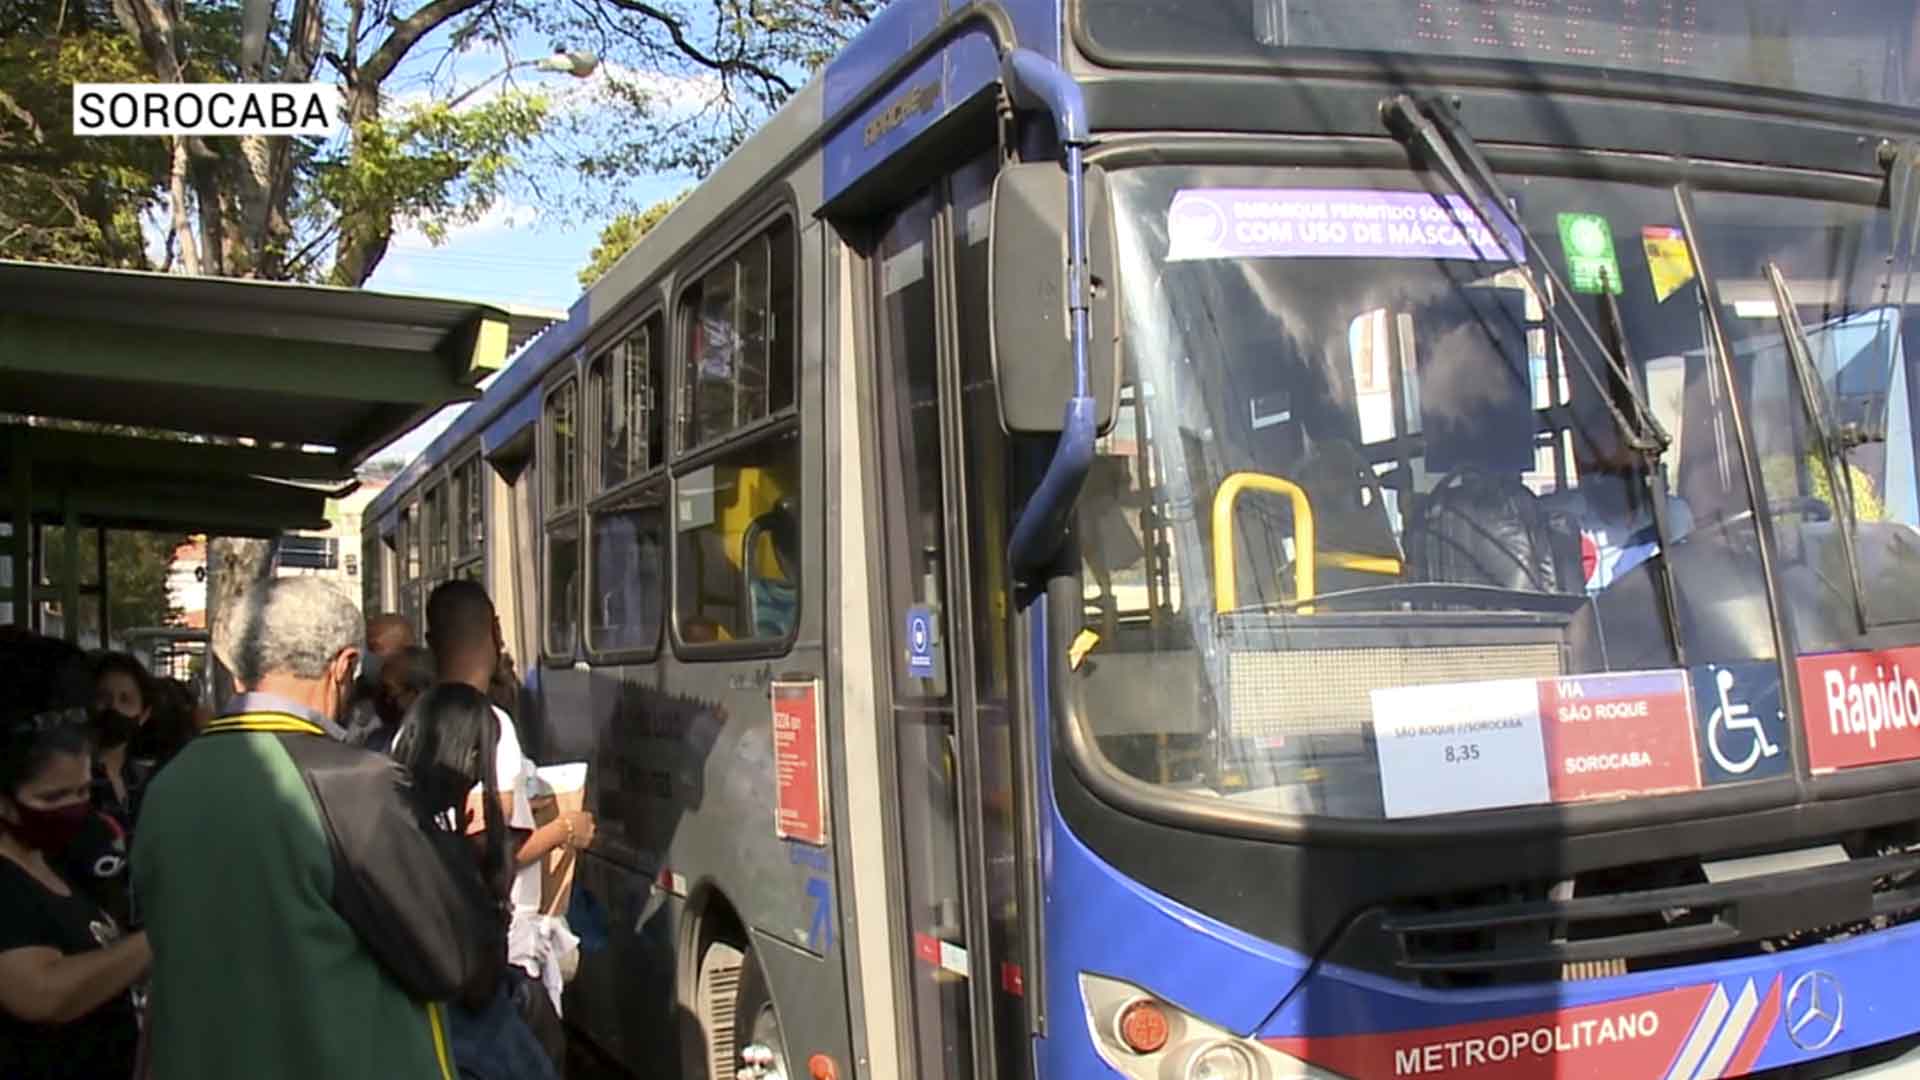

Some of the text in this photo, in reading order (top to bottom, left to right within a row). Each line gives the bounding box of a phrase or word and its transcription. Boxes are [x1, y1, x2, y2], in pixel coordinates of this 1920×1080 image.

[1236, 219, 1498, 247] COM USO DE MÁSCARA
[1557, 680, 1585, 699] VIA
[1558, 701, 1649, 723] SÃO ROQUE
[1823, 664, 1920, 749] Rápido
[1444, 744, 1480, 764] 8,35
[1564, 751, 1651, 775] SOROCABA
[1395, 1010, 1660, 1075] METROPOLITANO
